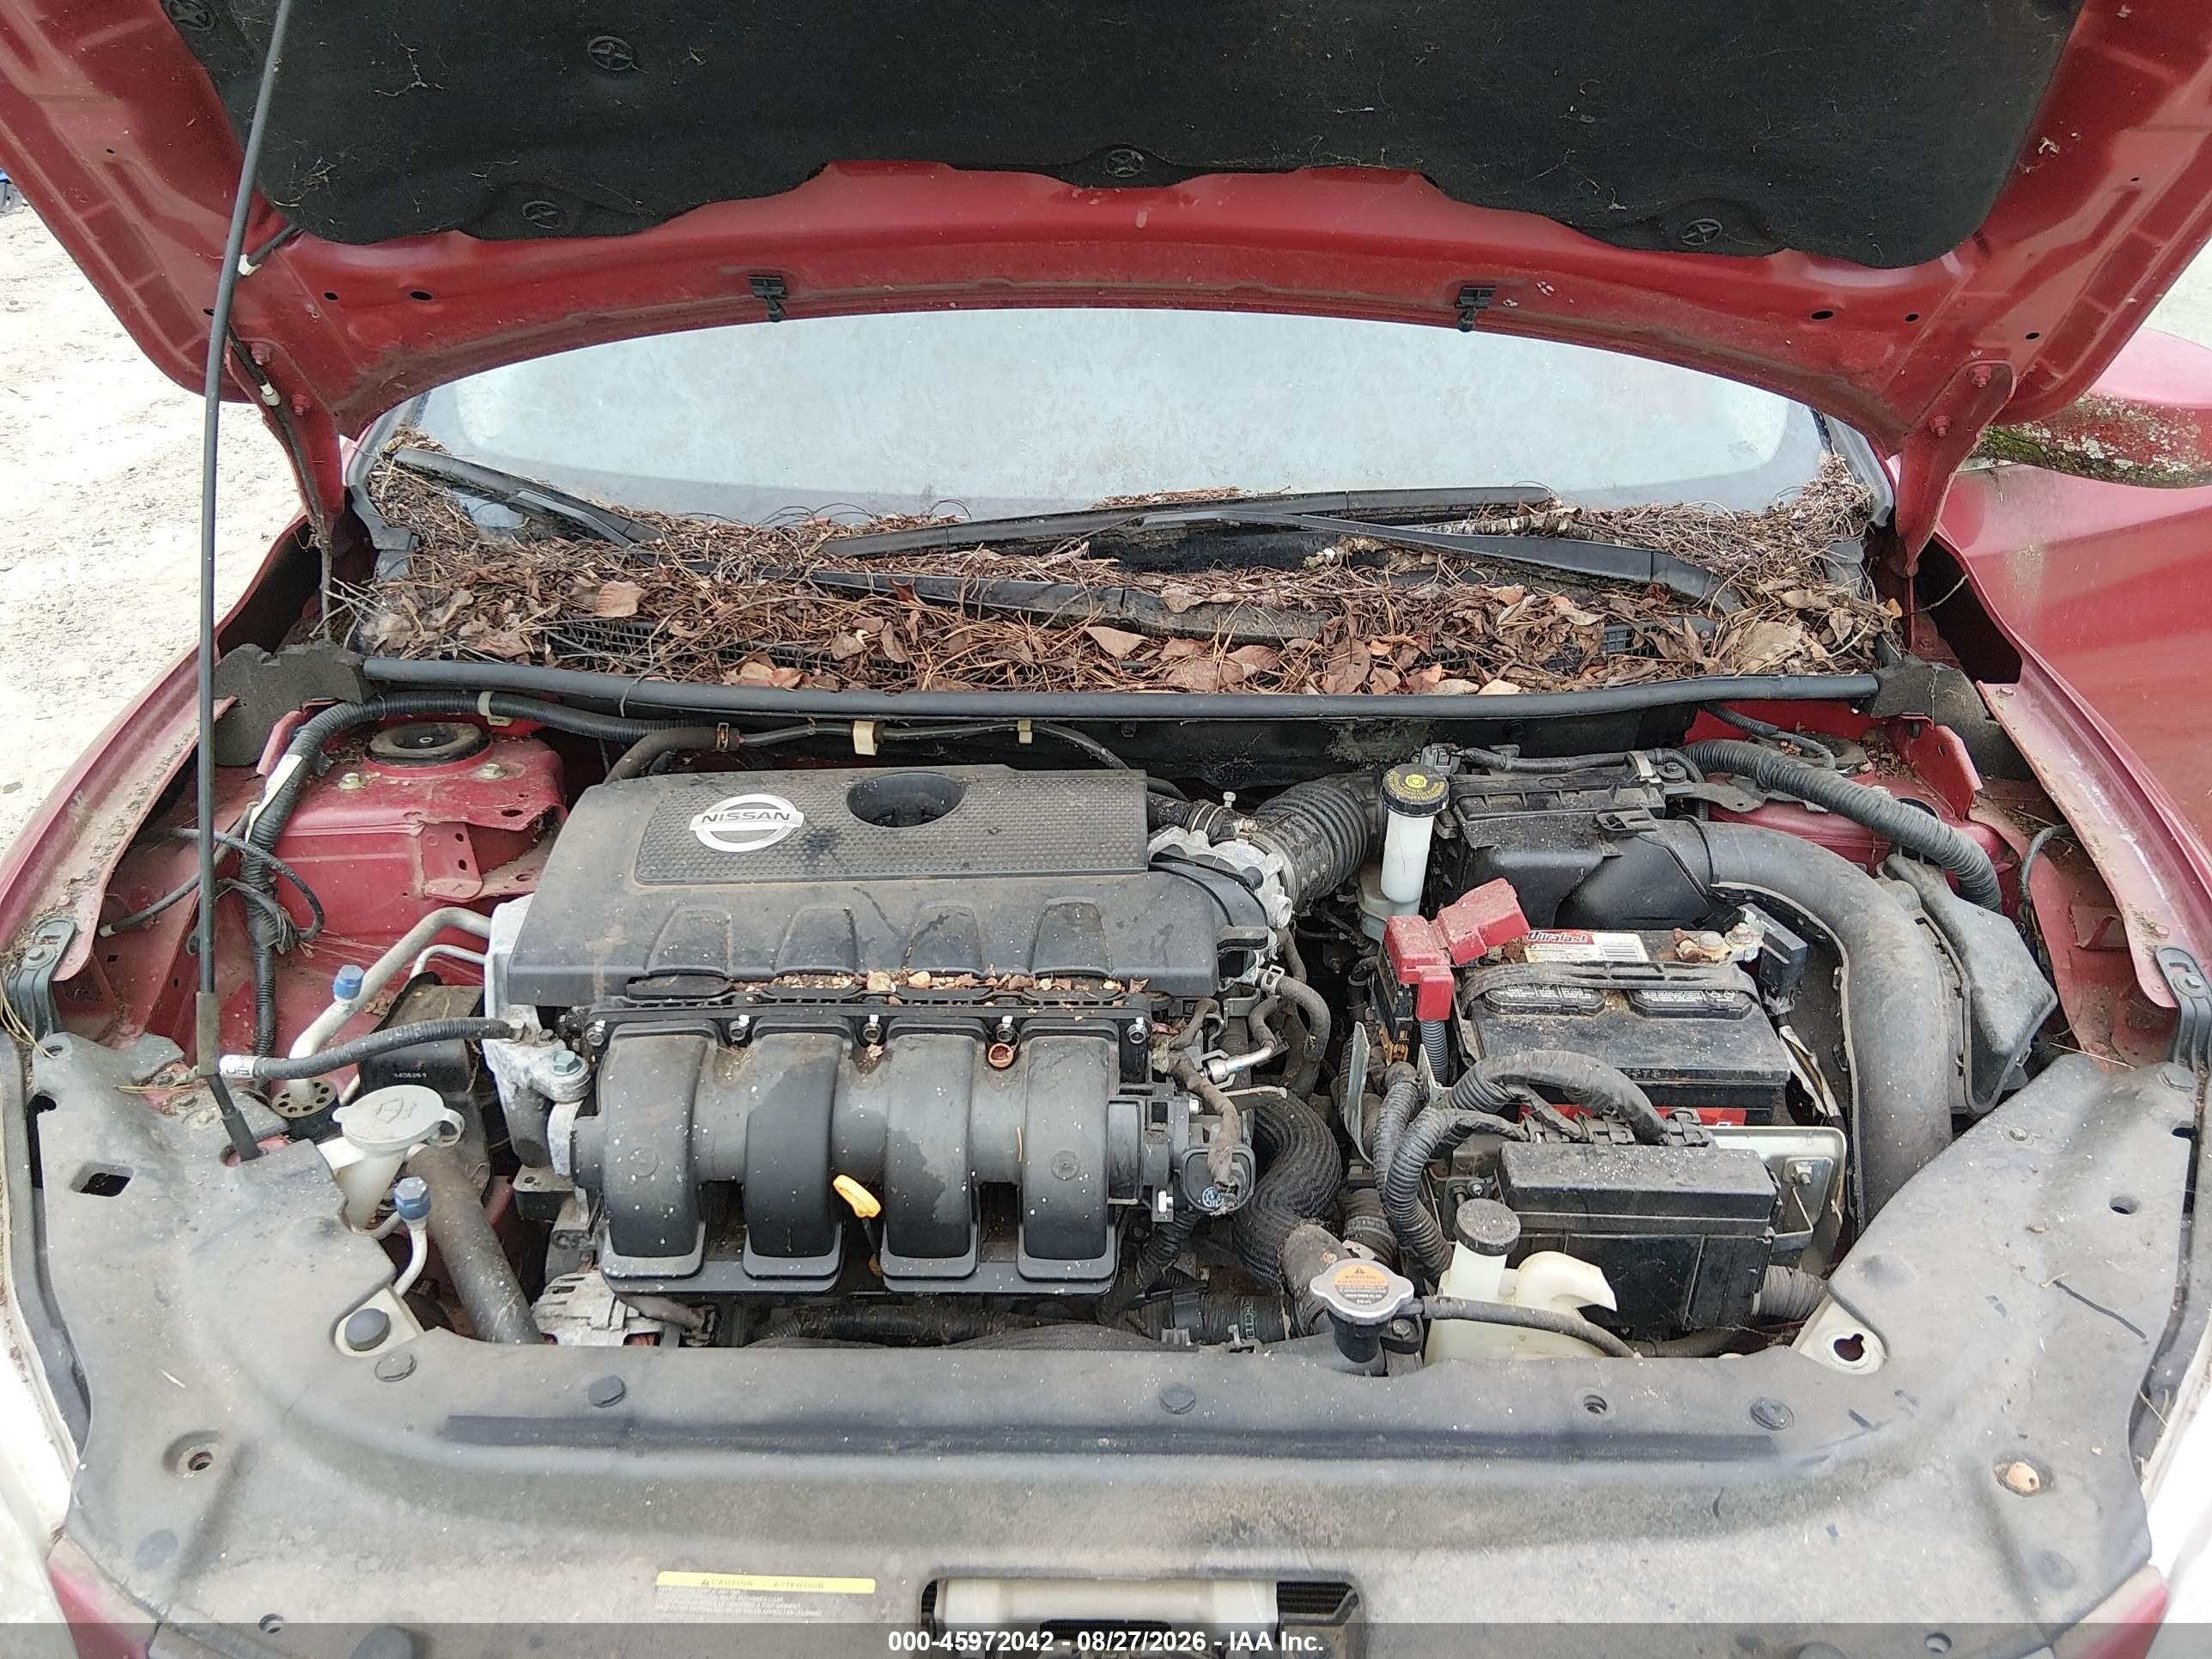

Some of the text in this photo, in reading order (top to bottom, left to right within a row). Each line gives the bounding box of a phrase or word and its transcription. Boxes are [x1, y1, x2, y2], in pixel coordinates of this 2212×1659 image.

[701, 811, 790, 823] NISSAN
[1526, 931, 1588, 943] Duralast
[711, 1578, 753, 1587] CAUTION
[773, 1580, 824, 1589] ATTENTION
